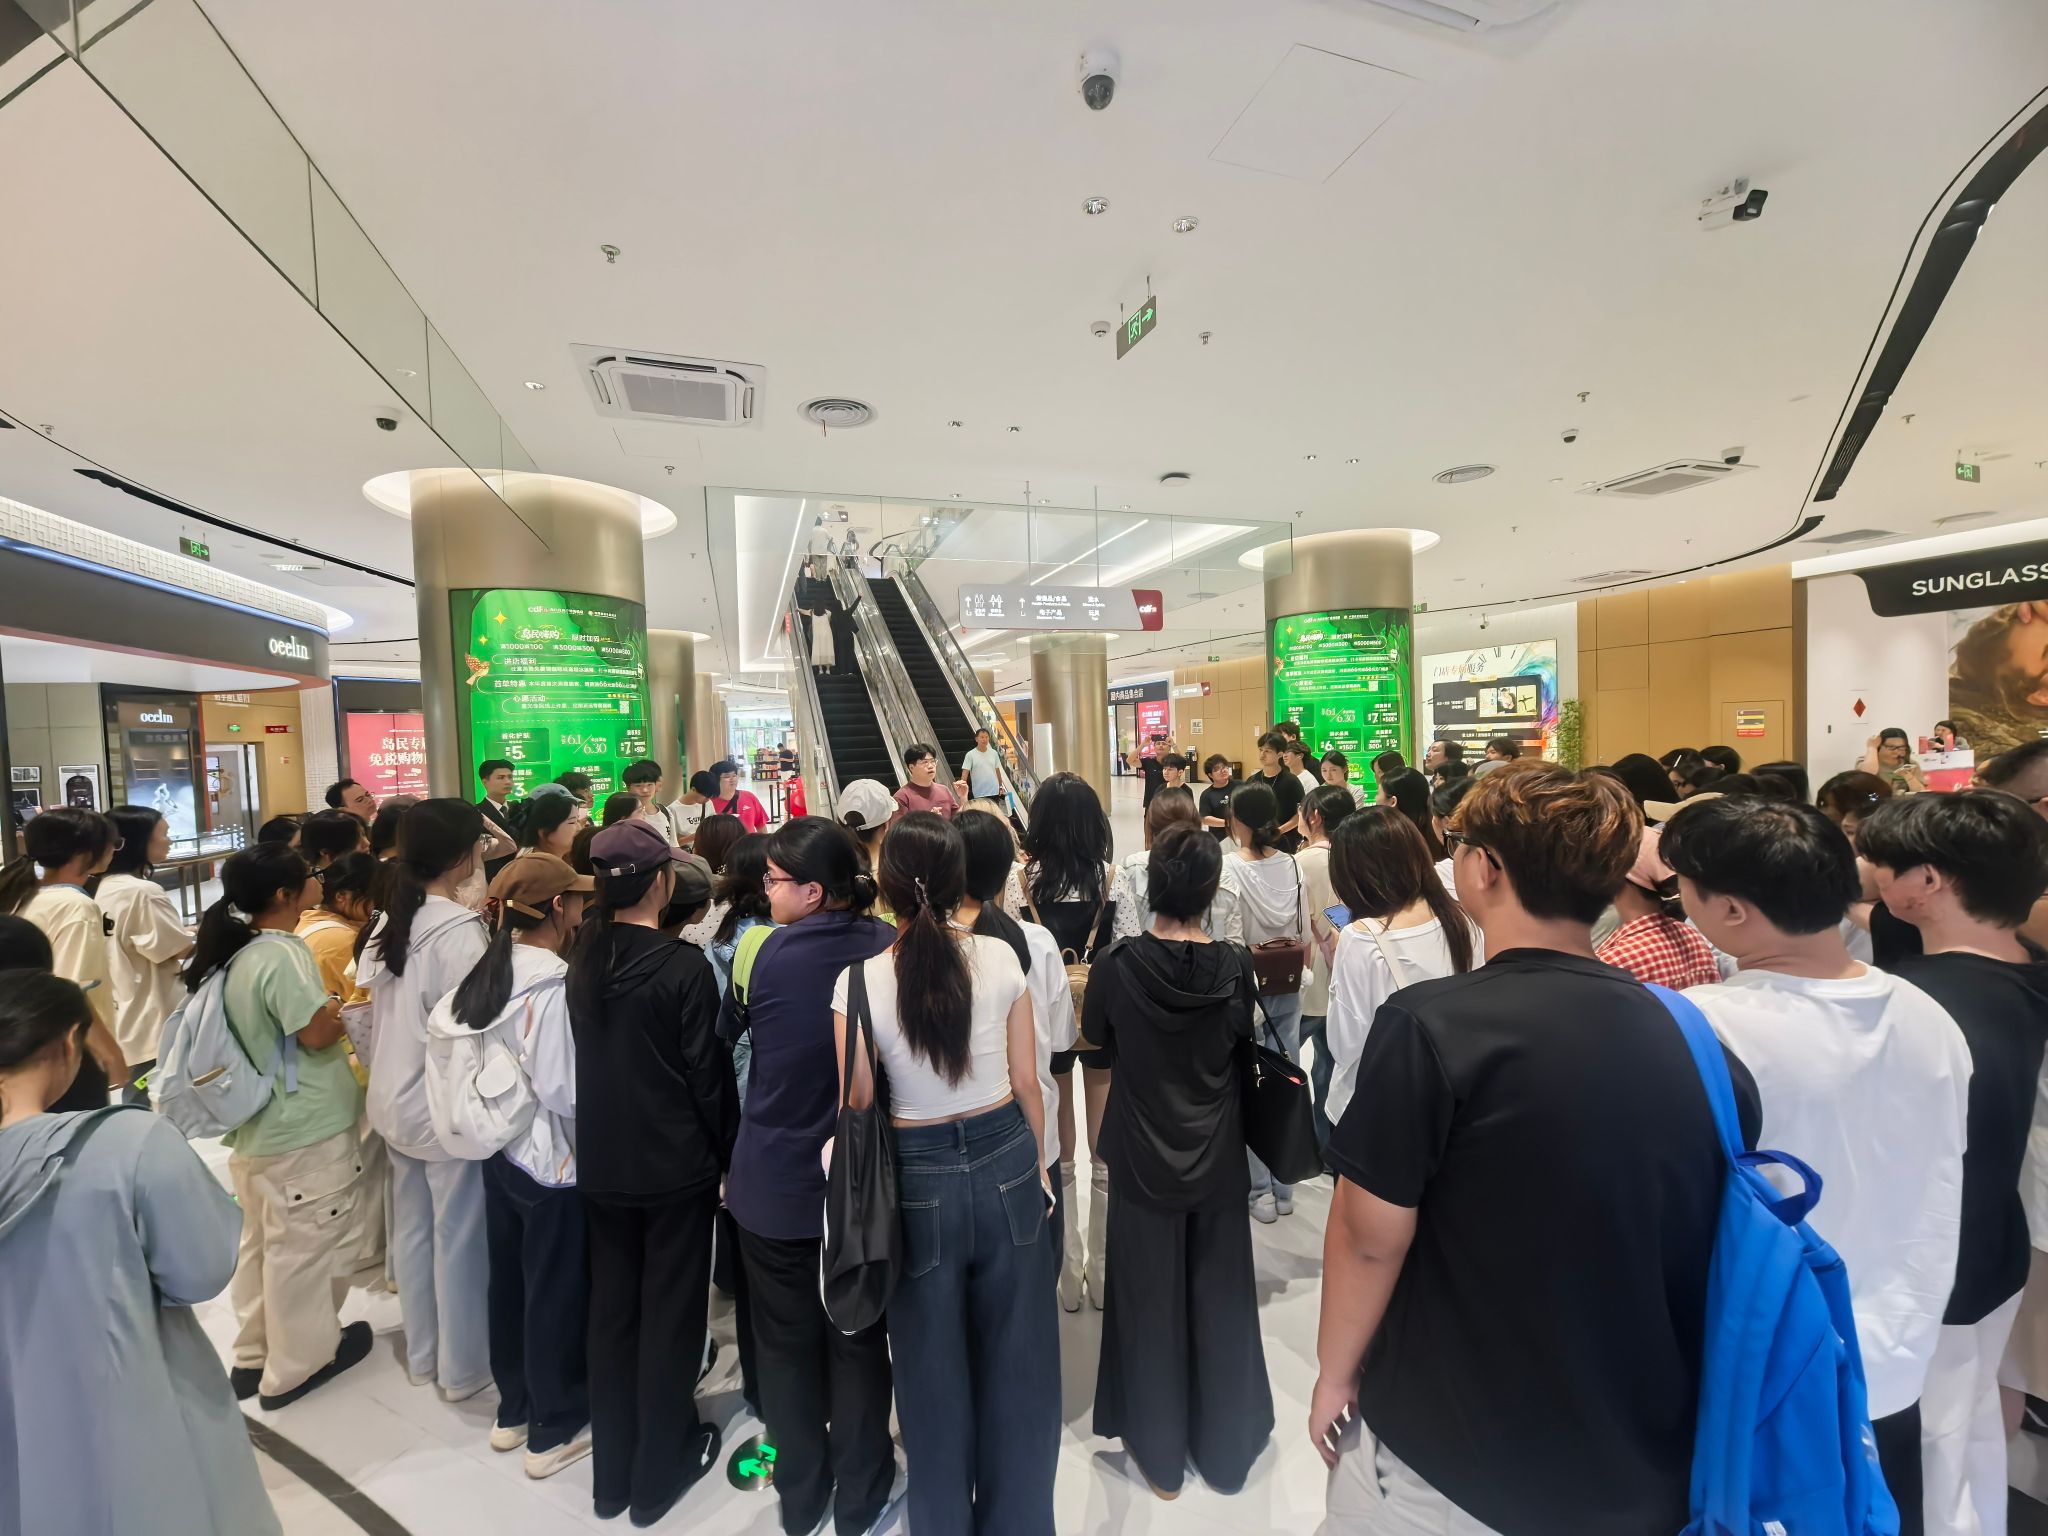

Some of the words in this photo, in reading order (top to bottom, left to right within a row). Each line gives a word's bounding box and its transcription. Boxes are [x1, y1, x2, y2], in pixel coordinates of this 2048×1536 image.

[583, 744, 607, 754] 6.30
[369, 752, 427, 767] 免税购物
